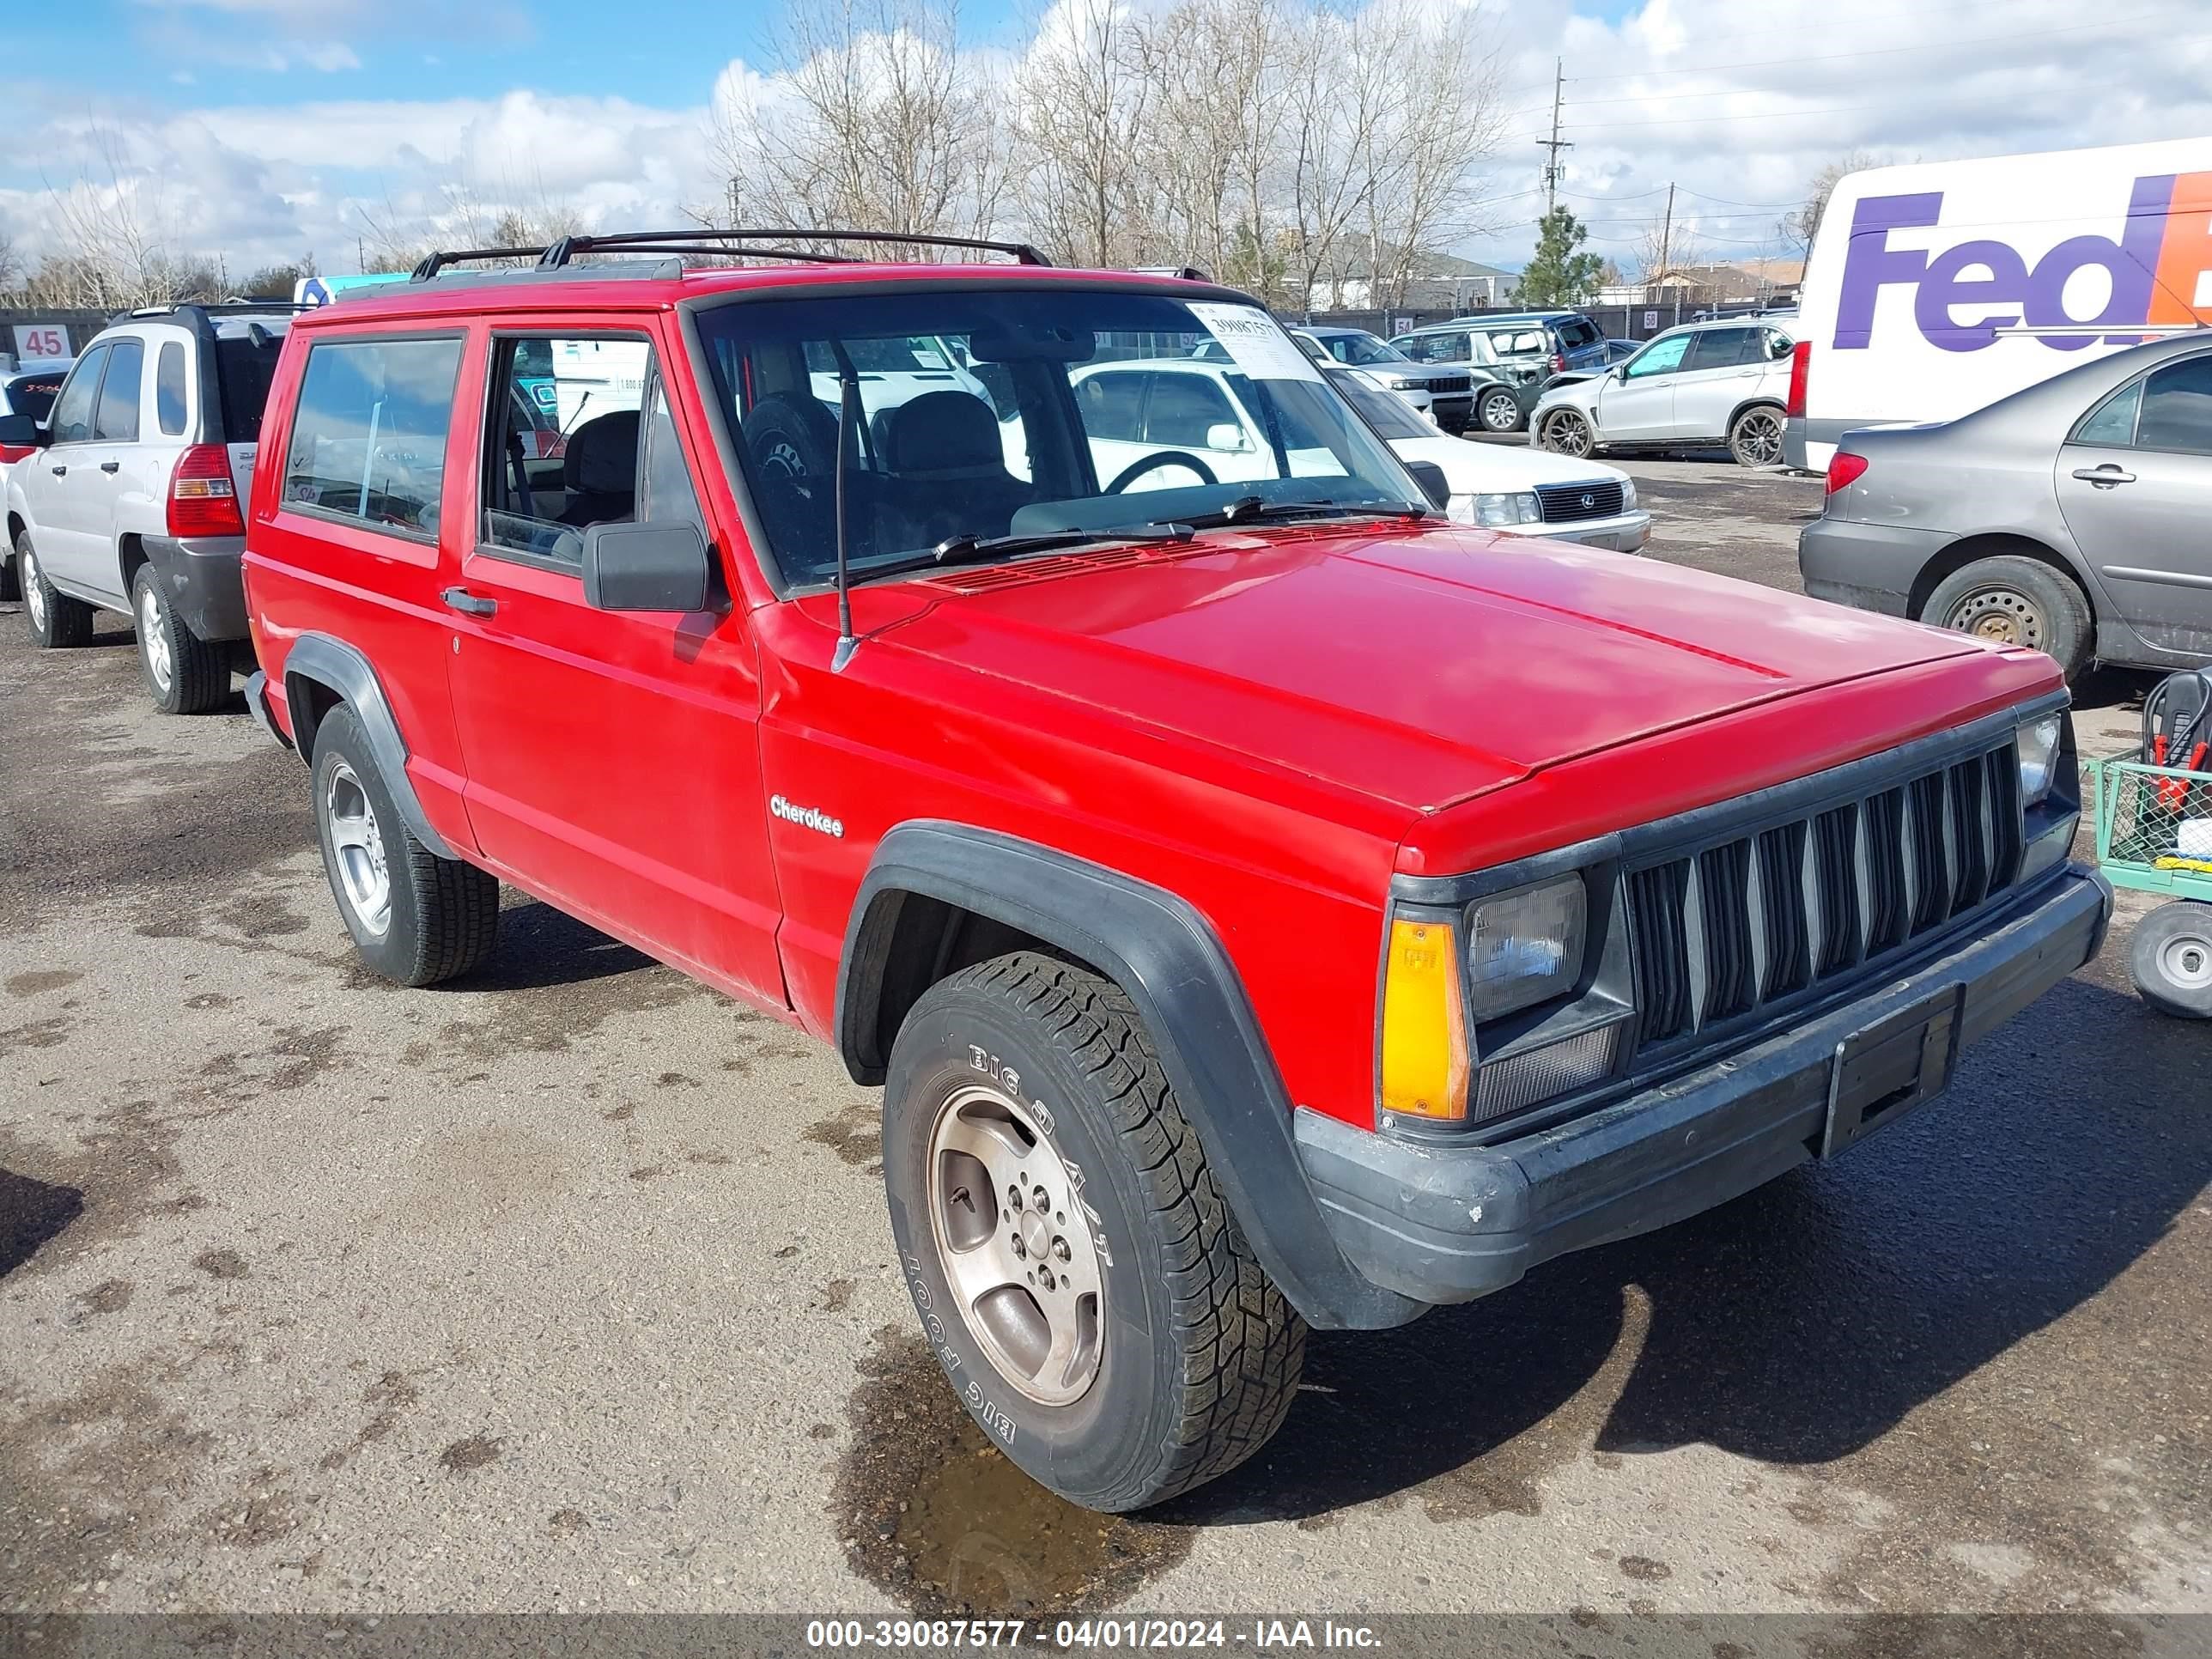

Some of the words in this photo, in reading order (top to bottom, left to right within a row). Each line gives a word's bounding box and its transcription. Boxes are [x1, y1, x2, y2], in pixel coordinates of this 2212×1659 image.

[1212, 319, 1279, 338] 39087577
[1398, 322, 1410, 333] 54
[1647, 314, 1656, 325] 58
[26, 331, 62, 356] 45
[770, 793, 844, 838] Cherokee
[968, 1043, 1021, 1096] BIG
[903, 1249, 962, 1371] FOOT
[965, 1381, 1018, 1446] BIG
